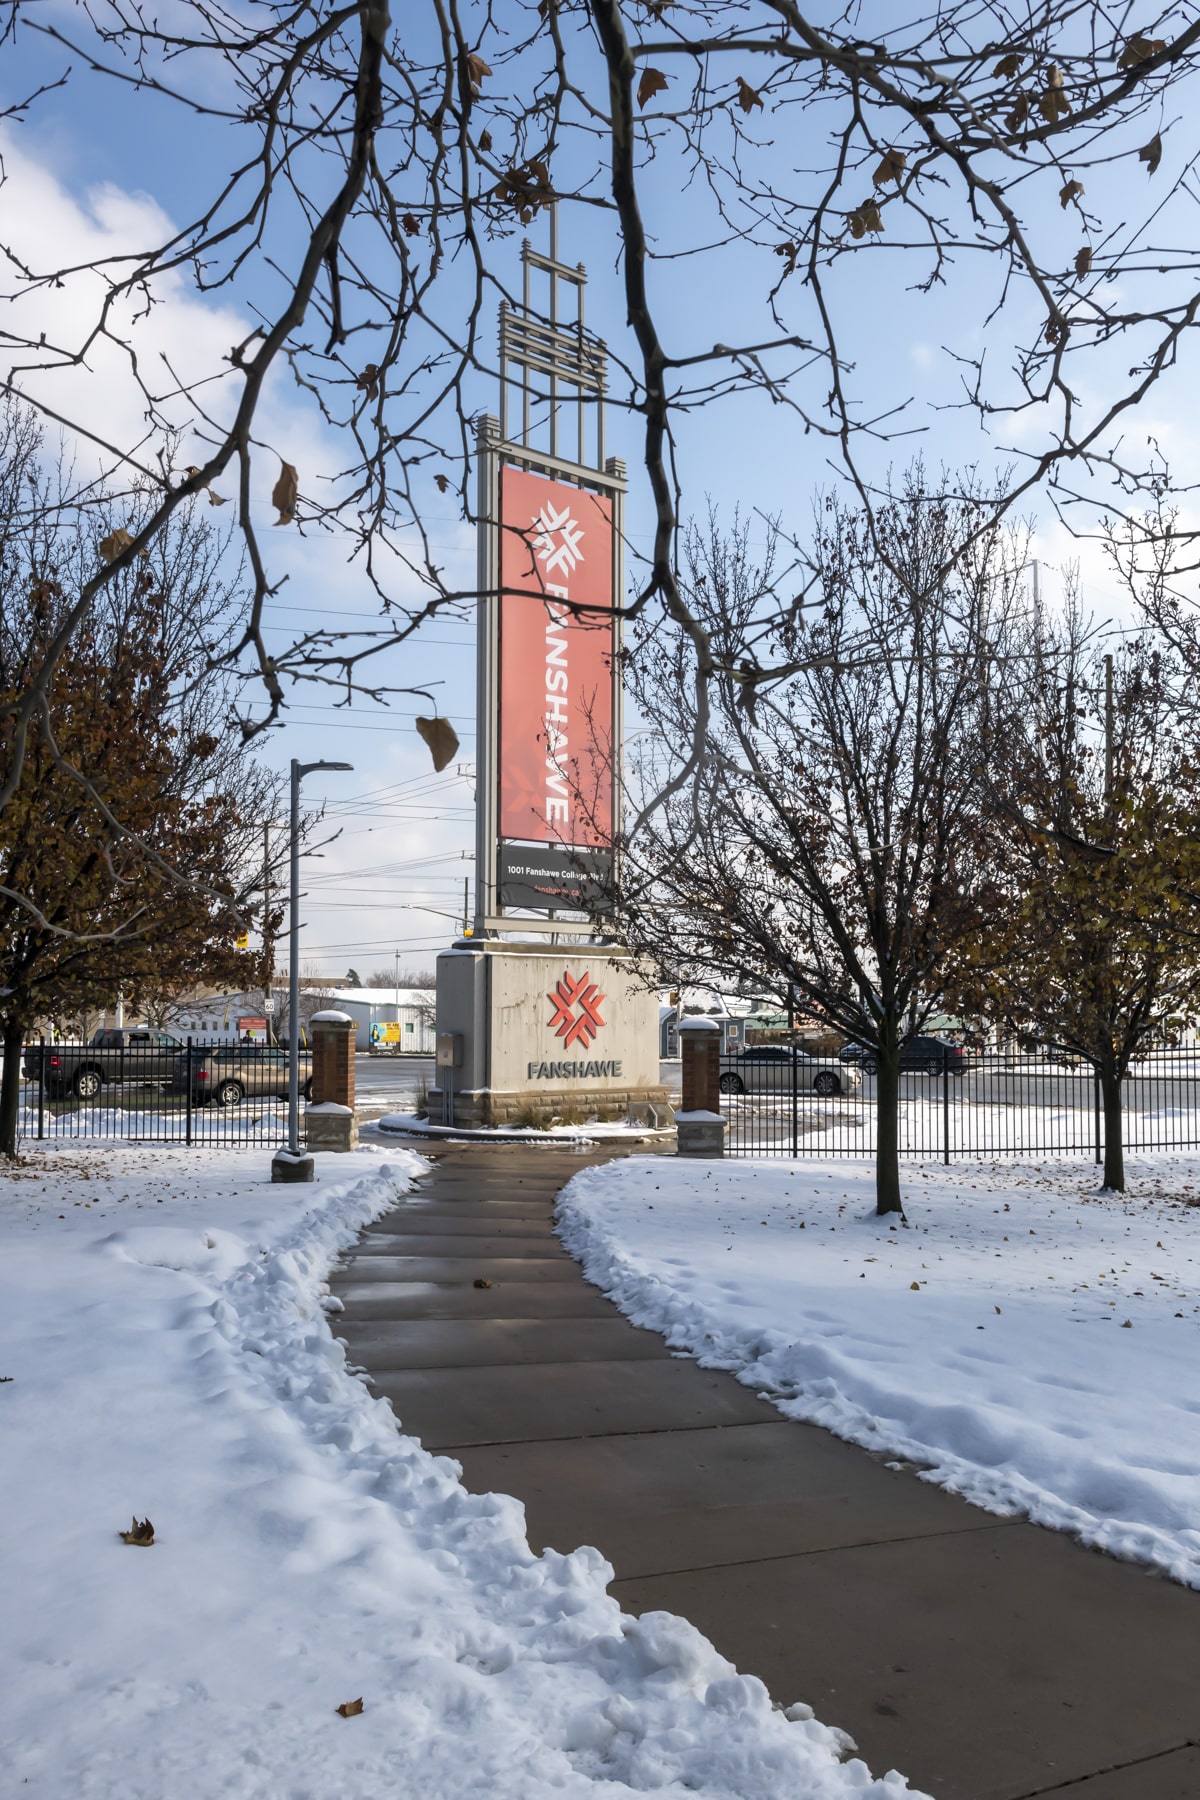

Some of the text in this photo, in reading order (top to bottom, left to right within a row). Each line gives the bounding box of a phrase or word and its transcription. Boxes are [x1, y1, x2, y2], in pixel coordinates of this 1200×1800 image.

[545, 582, 569, 823] FANSHAWE
[507, 866, 524, 874] 1001
[525, 867, 560, 877] Fanshawe
[527, 1060, 622, 1079] FANSHAWE
